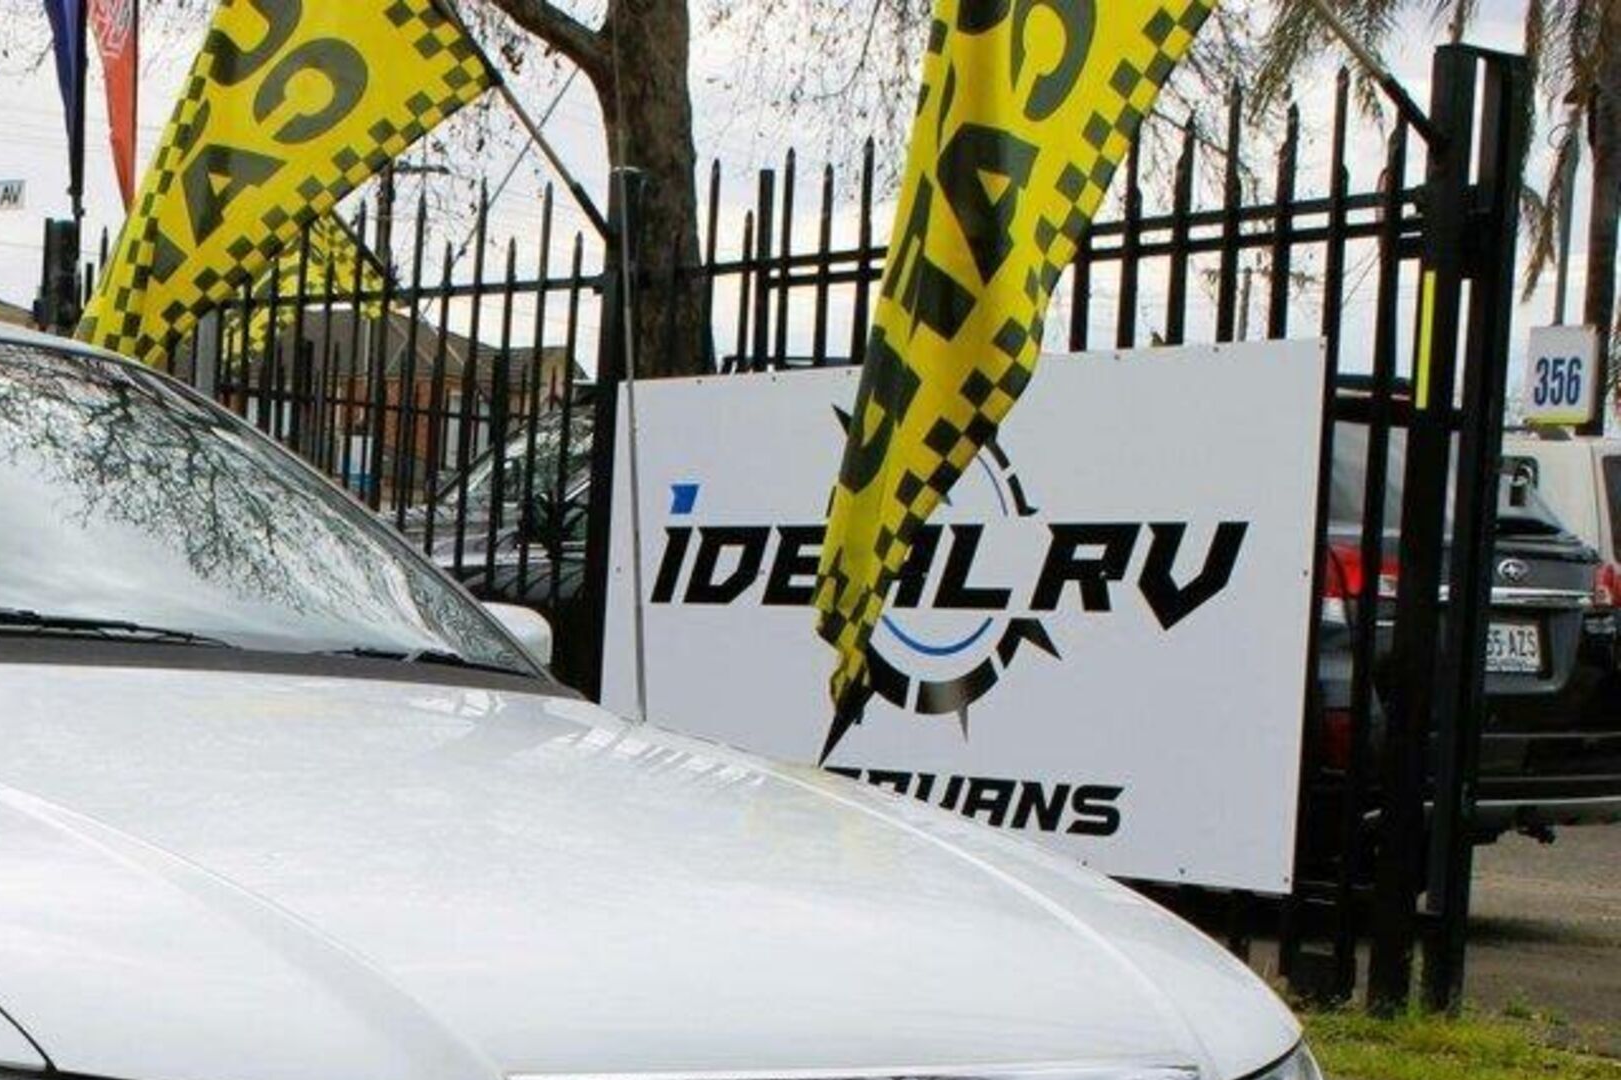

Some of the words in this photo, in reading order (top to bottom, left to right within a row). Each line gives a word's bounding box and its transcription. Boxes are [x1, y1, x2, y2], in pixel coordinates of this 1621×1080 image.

[0, 183, 23, 206] AV
[1533, 357, 1583, 406] 356
[1030, 521, 1249, 631] RV
